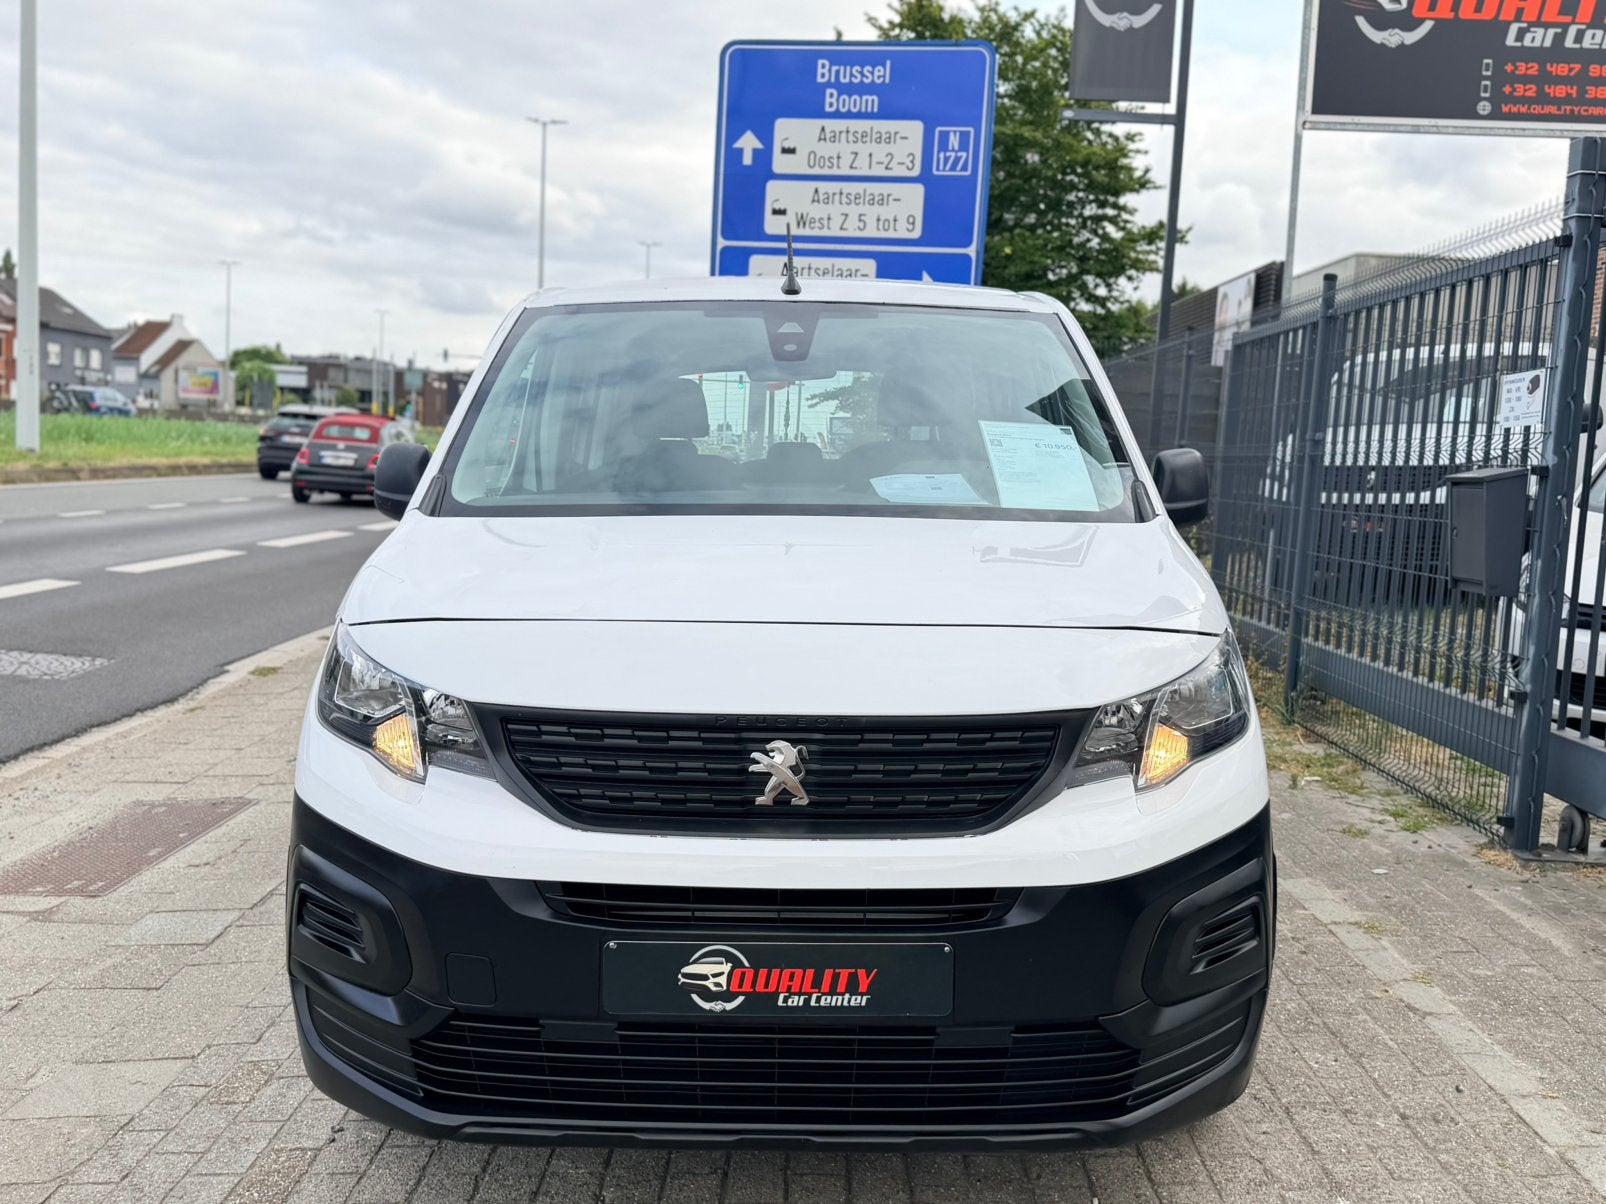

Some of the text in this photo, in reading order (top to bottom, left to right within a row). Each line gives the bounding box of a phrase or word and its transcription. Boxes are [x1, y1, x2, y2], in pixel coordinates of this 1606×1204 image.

[1505, 22, 1606, 49] Car Ce
[816, 58, 891, 84] Brussel
[1504, 61, 1539, 76] +32
[1546, 62, 1582, 77] 487
[824, 88, 879, 113] Boom
[1502, 83, 1538, 98] +32
[1544, 84, 1578, 99] 484
[817, 125, 909, 145] Aartselaar-
[948, 131, 960, 151] N
[807, 150, 842, 170] Oost
[938, 151, 967, 172] 177
[811, 187, 902, 207] Aartselaar-
[795, 211, 832, 231] West
[876, 214, 898, 232] tot
[906, 214, 917, 233] 9
[714, 715, 849, 727] PEUGEOT
[729, 968, 878, 993] QUALITY
[777, 992, 871, 1007] Car Center
